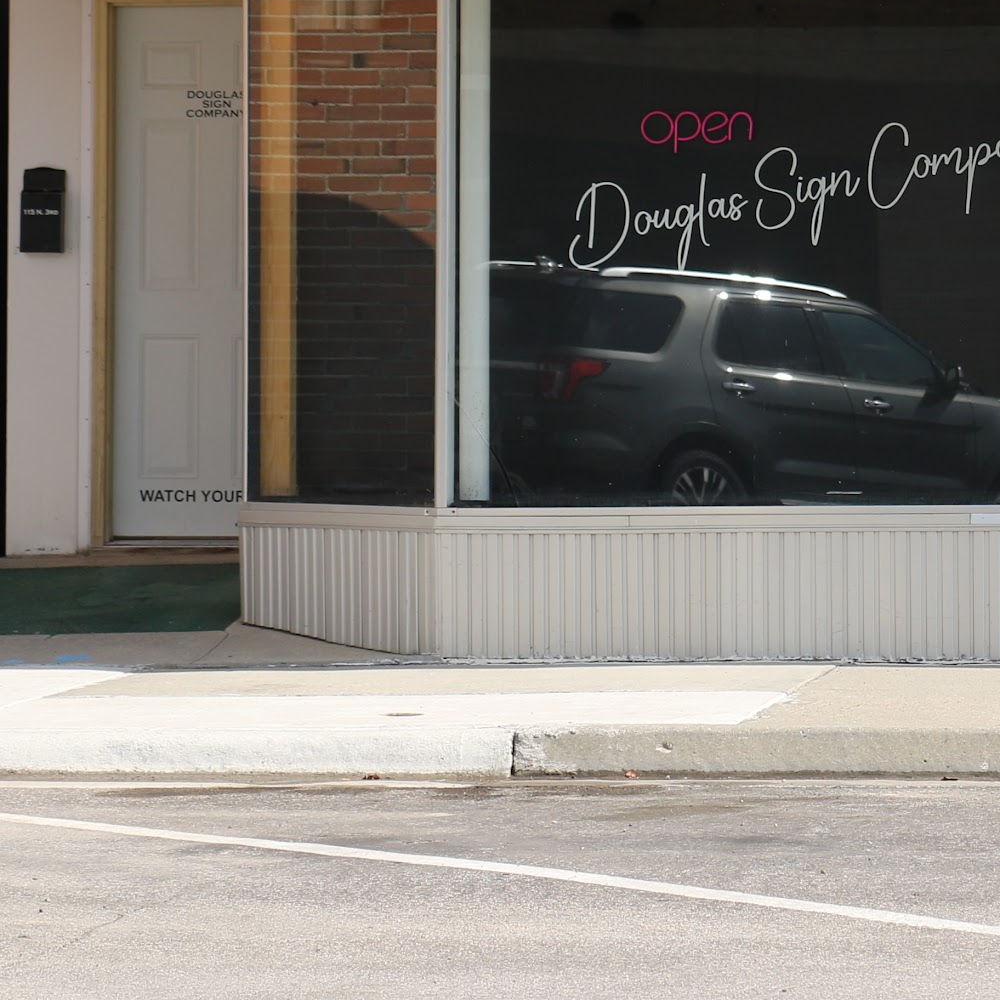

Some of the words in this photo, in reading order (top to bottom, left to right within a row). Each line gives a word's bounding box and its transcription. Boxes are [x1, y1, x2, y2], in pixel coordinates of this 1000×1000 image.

[202, 100, 231, 108] SIGN
[640, 111, 753, 153] open
[569, 173, 748, 272] Douglas
[754, 147, 861, 246] Sign
[140, 490, 196, 502] WATCH
